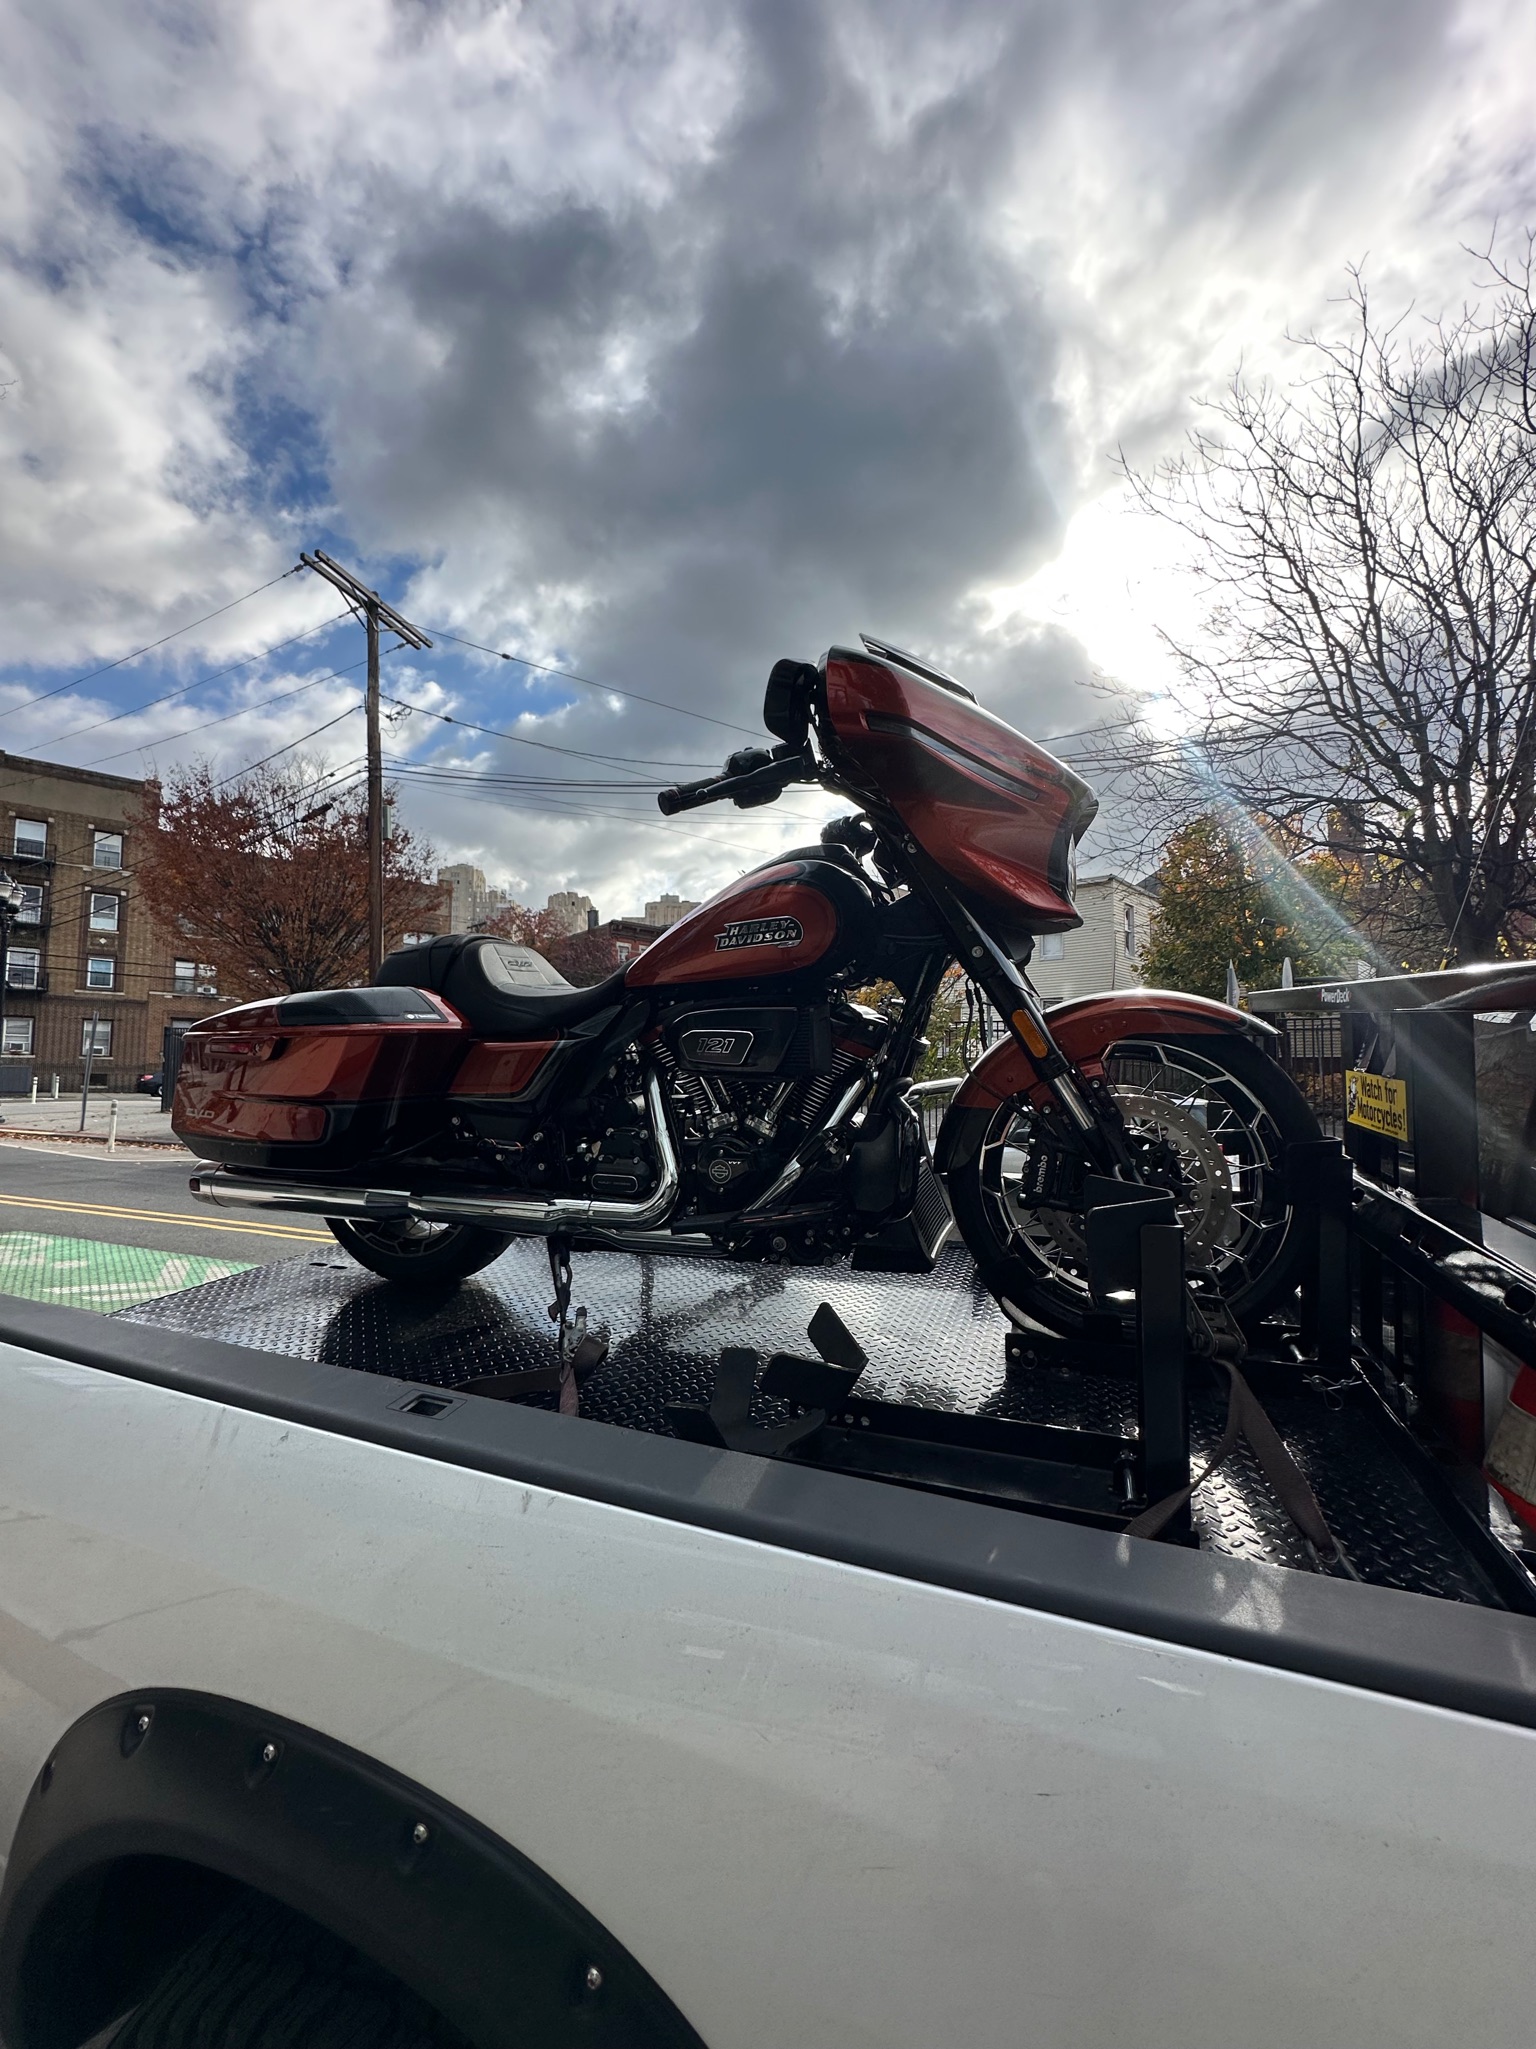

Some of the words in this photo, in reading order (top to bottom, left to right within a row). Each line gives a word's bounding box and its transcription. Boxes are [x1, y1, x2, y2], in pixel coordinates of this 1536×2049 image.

[720, 929, 797, 947] DAVIDSON
[729, 920, 795, 936] HARLEY-
[696, 1038, 736, 1054] 121
[1360, 1075, 1383, 1101] Watch
[1384, 1081, 1398, 1105] for
[1357, 1096, 1406, 1132] Motorcycles!
[1033, 1154, 1048, 1194] brembo
